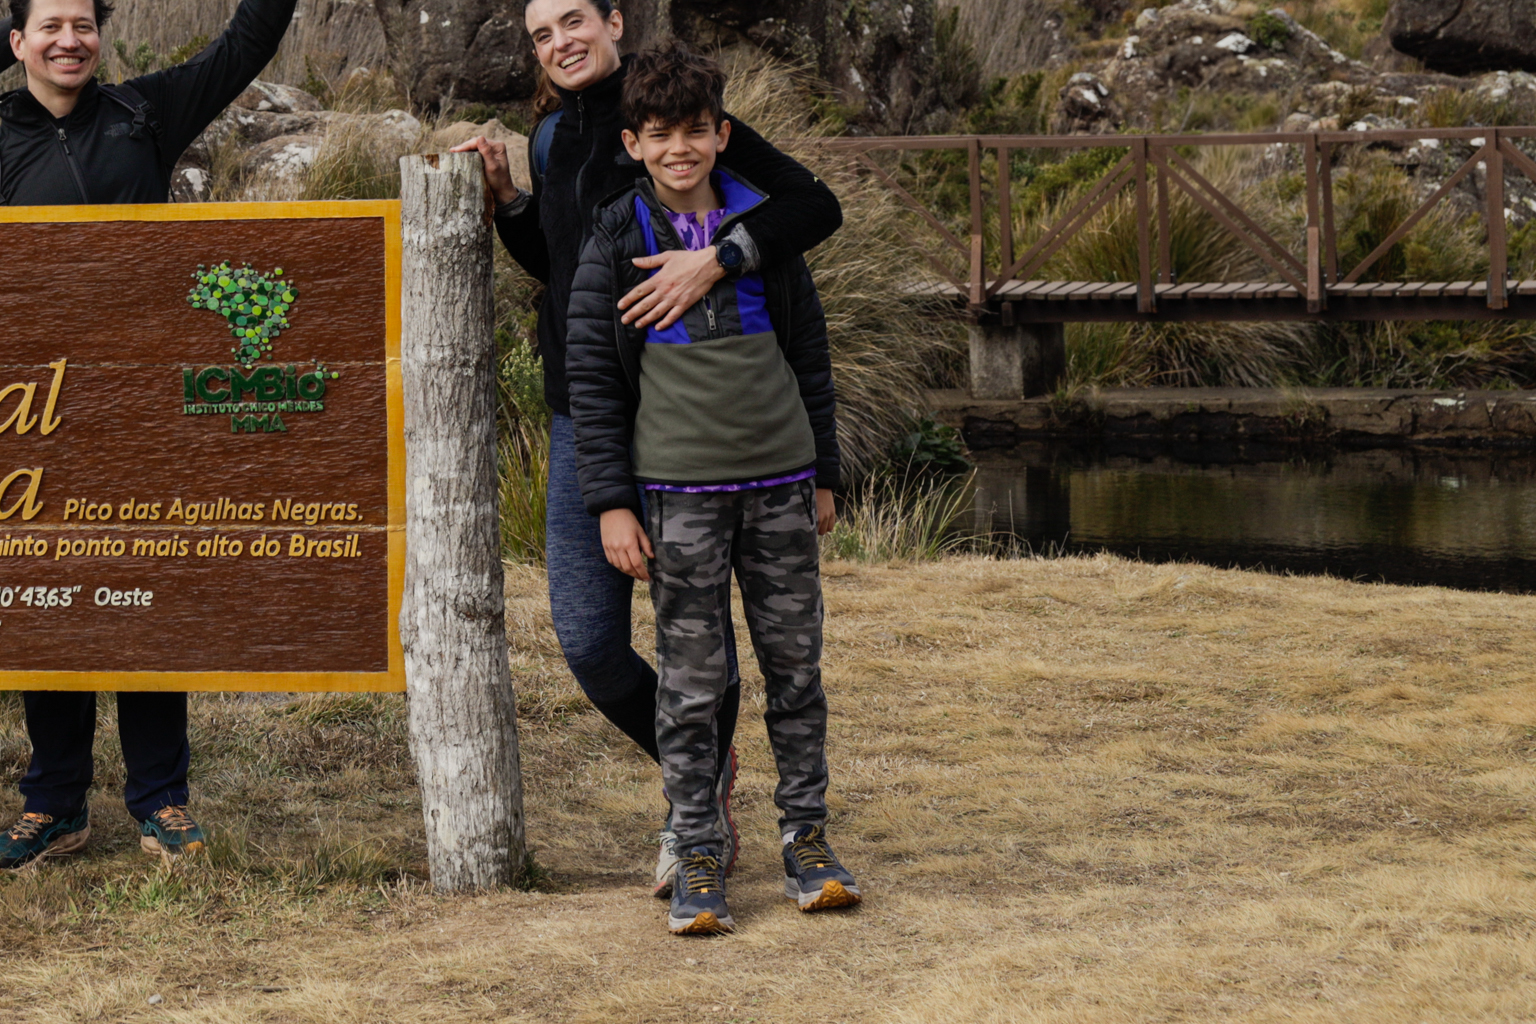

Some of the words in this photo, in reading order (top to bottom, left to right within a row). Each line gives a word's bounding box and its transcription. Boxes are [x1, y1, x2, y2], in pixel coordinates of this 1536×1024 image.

[182, 365, 325, 403] ICMBio
[183, 403, 240, 415] INSTITUTO
[241, 402, 276, 413] CHICO
[277, 400, 324, 413] MENDES
[230, 413, 287, 433] MMA
[63, 498, 113, 521] Pico
[118, 498, 162, 521] das
[166, 498, 265, 525] Agulhas
[55, 535, 126, 561] ponto
[132, 534, 190, 557] mais
[196, 534, 244, 558] alto
[249, 534, 281, 558] do
[287, 533, 363, 558] Brasil.
[93, 585, 154, 607] Oeste
